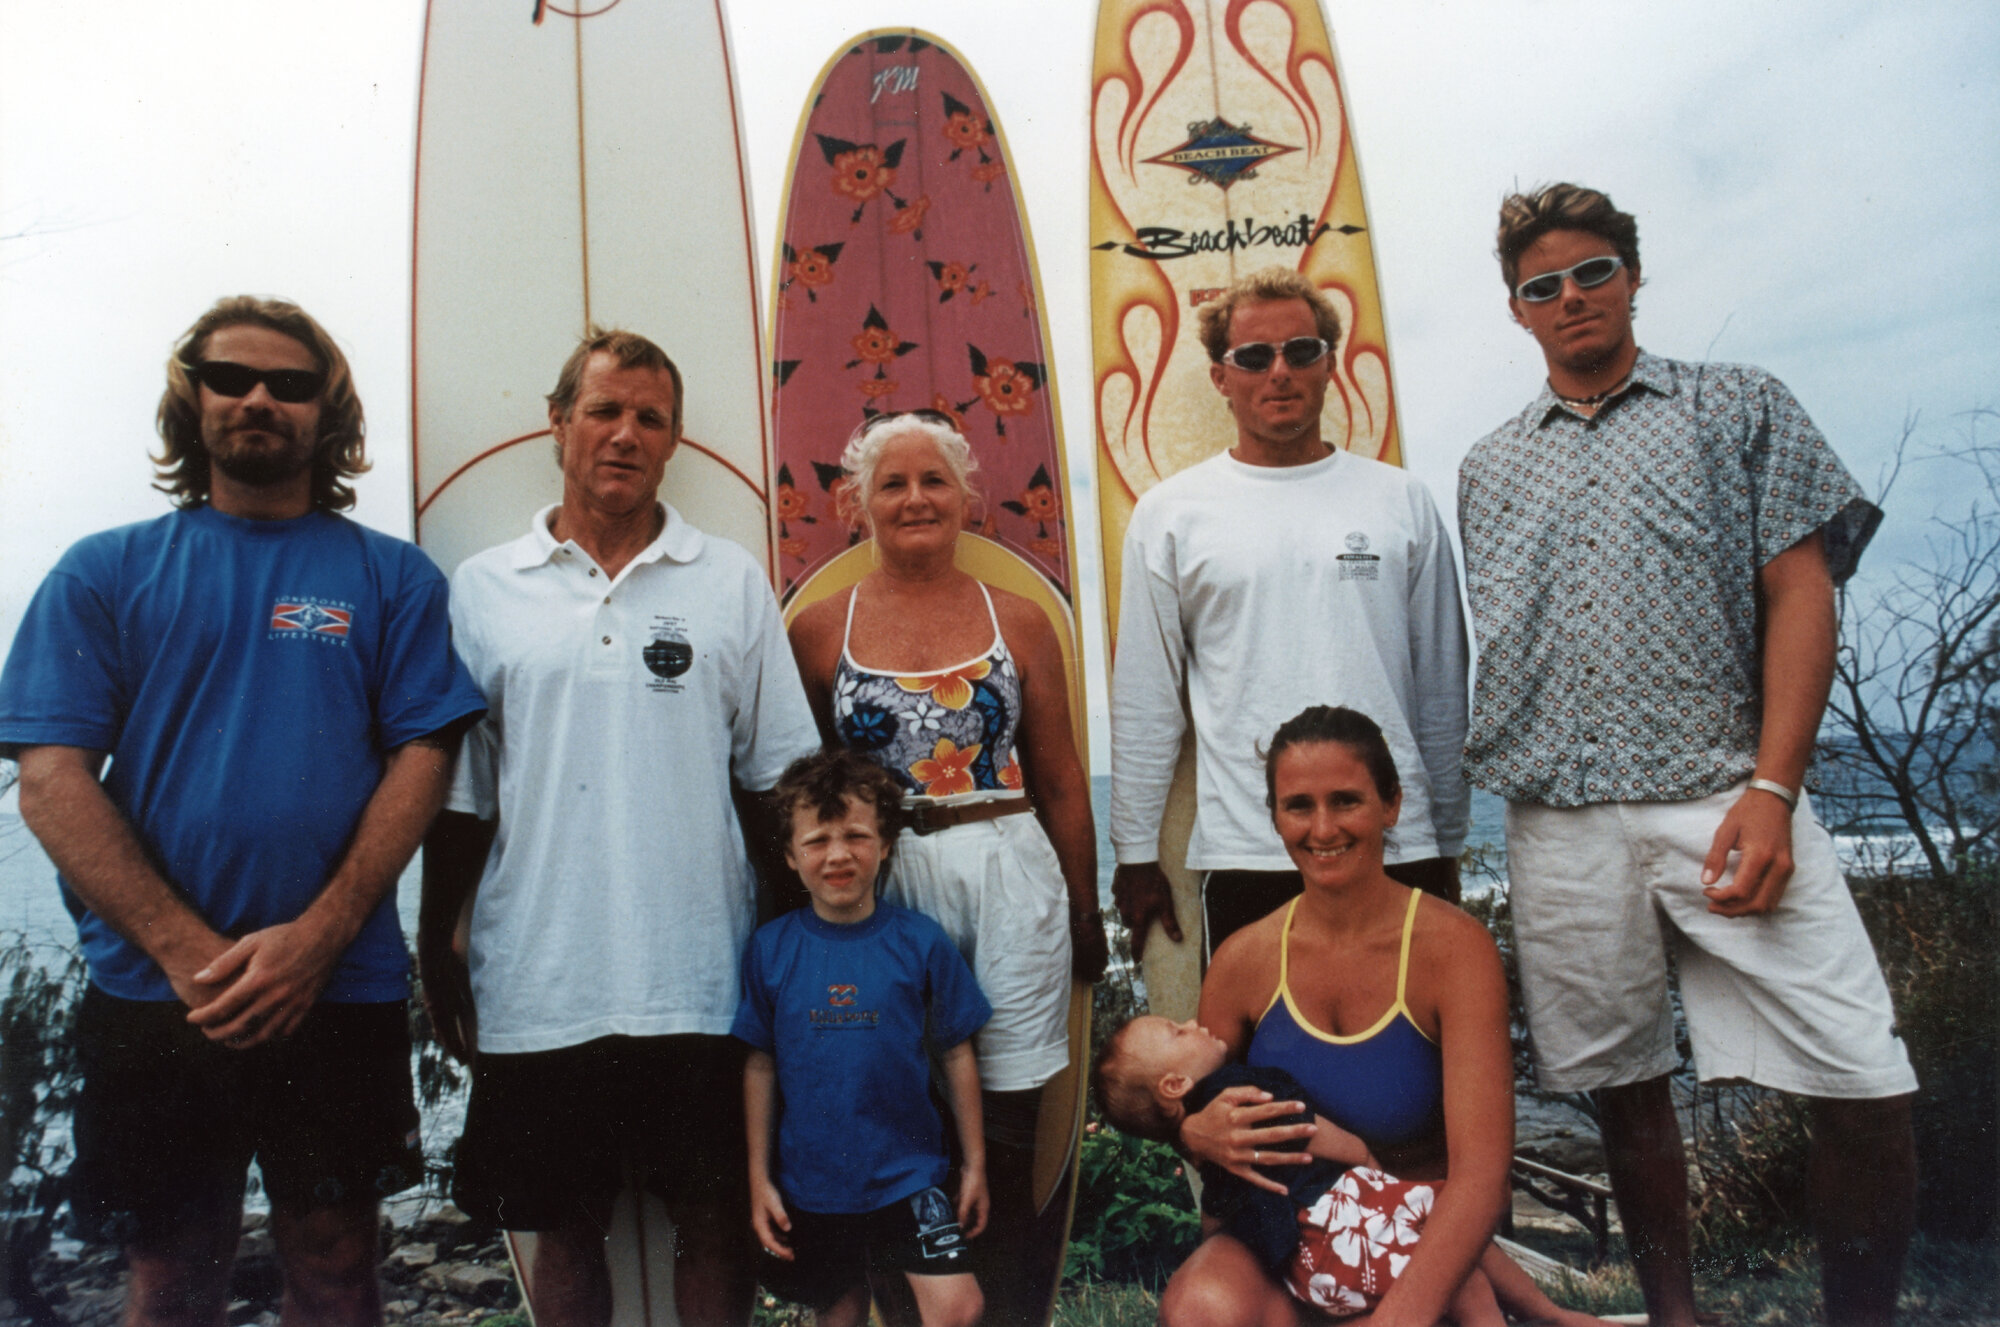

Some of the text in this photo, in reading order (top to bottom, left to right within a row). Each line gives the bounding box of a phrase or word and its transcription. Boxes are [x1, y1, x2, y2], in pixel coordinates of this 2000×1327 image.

[1173, 145, 1270, 162] BEACH BEAT
[274, 595, 356, 610] LONGBOARD
[267, 631, 348, 648] LIFESTYLE
